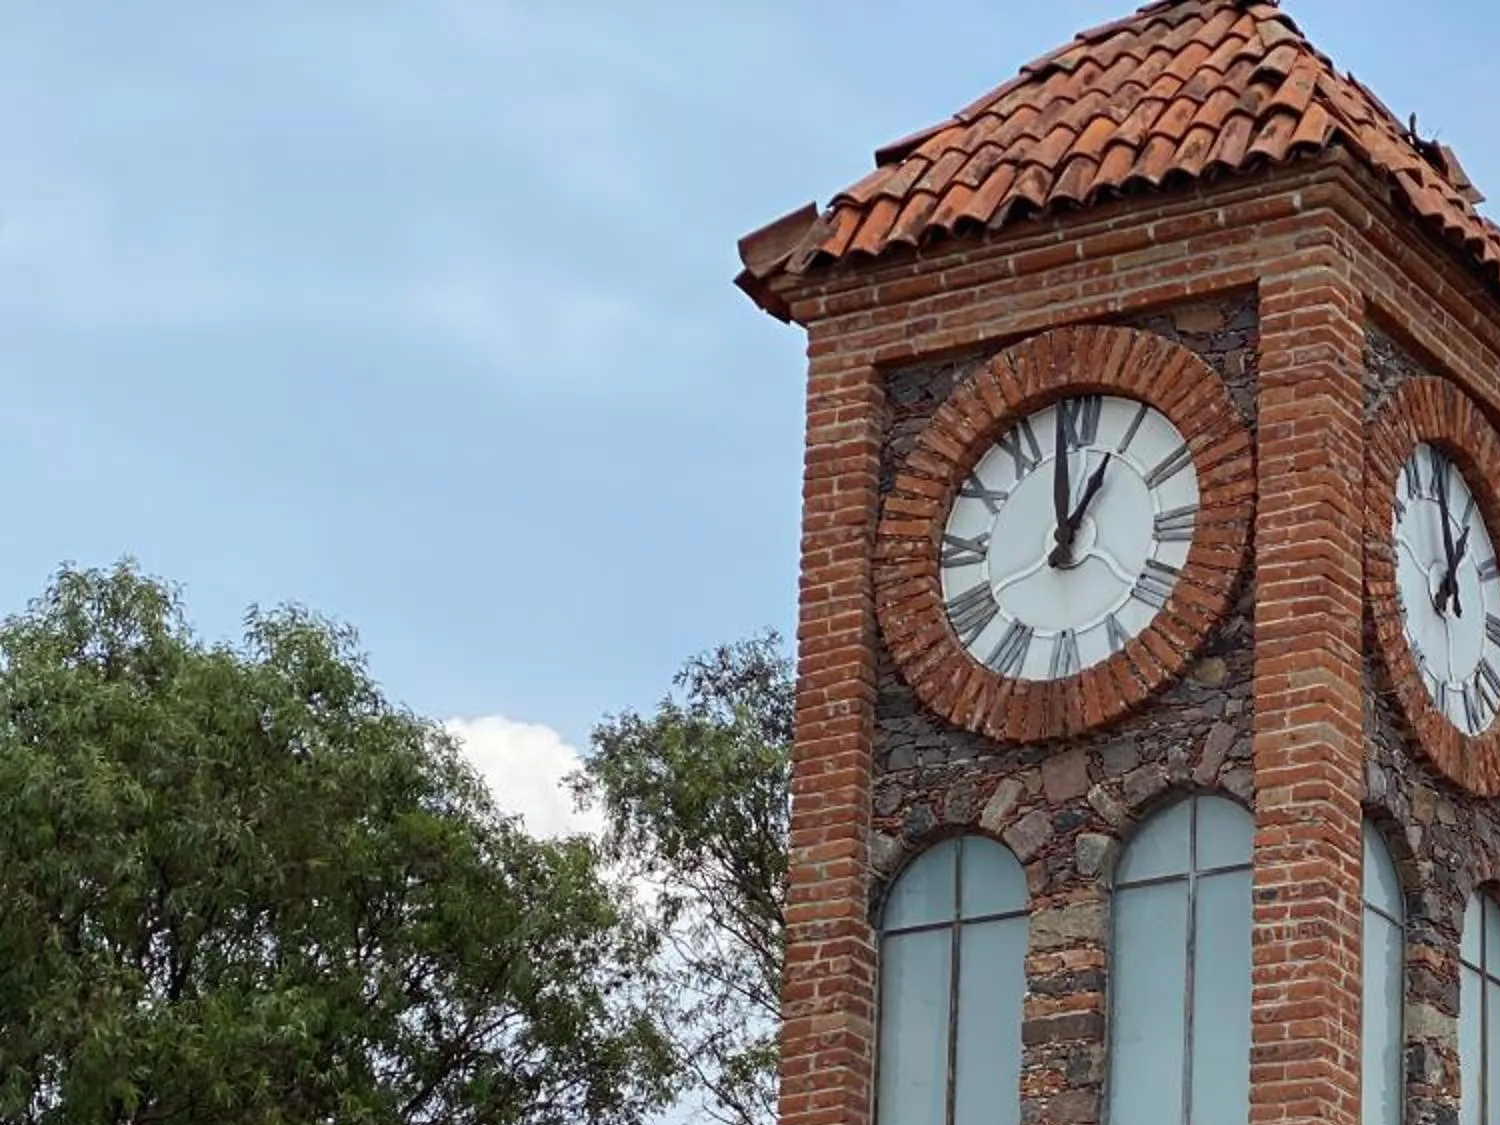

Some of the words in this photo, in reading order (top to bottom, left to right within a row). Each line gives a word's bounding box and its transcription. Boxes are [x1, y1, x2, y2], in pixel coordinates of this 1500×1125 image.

[1118, 402, 1149, 454] I
[1144, 443, 1192, 491] II
[959, 474, 1009, 514] X
[1153, 504, 1200, 542] III
[942, 532, 991, 569] IX
